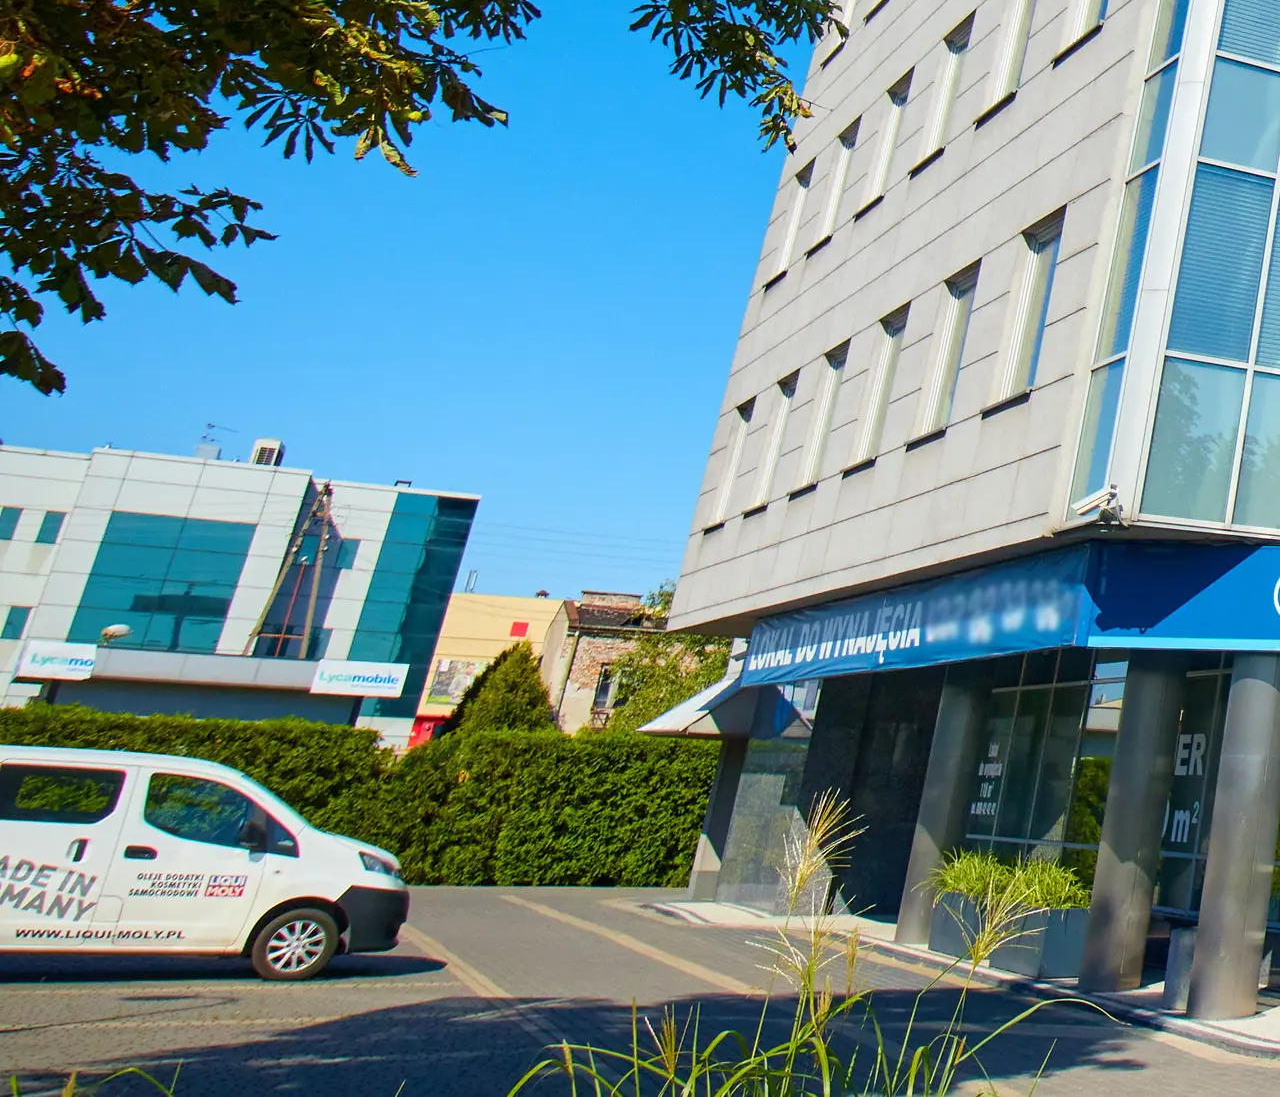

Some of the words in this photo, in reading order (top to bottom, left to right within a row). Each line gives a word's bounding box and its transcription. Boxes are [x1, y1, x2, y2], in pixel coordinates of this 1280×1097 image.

[748, 627, 795, 671] LOKAL
[795, 622, 821, 663] DO
[818, 601, 921, 664] WYNAJĘCIA
[318, 671, 400, 685] Lycamobile
[137, 872, 163, 881] OLEJE
[165, 873, 205, 882] DODATKI
[208, 875, 248, 886] LIQUI
[58, 870, 97, 897] IN
[150, 881, 203, 890] KOSMETYKI
[128, 888, 199, 897] SAMOCHODOWE
[204, 886, 244, 897] MOLY
[15, 927, 186, 940] WWW.LIQUI-MOLY.PL
